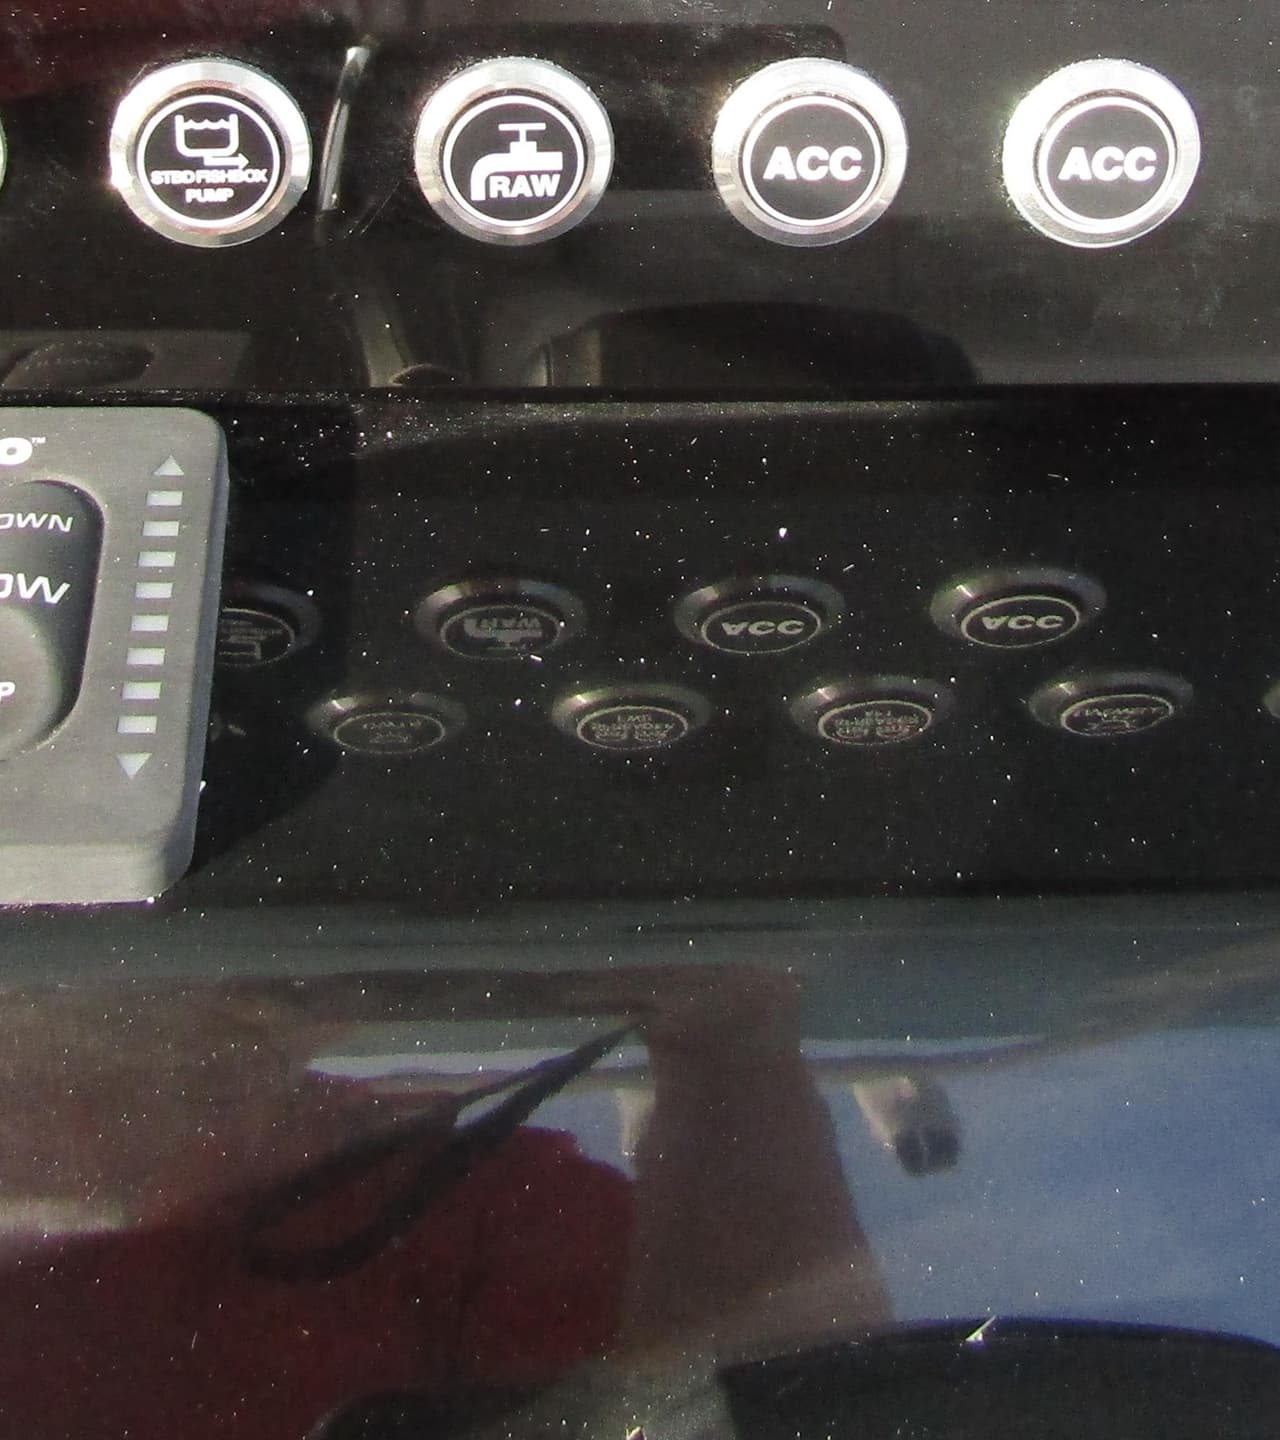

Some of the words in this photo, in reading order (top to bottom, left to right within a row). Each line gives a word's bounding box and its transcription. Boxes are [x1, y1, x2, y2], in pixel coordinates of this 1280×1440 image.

[763, 145, 863, 181] ACC
[1059, 145, 1157, 181] ACC
[151, 170, 195, 185] STBD
[195, 169, 268, 184] FISHBOX
[489, 174, 561, 198] RAW
[185, 188, 234, 203] PUMP
